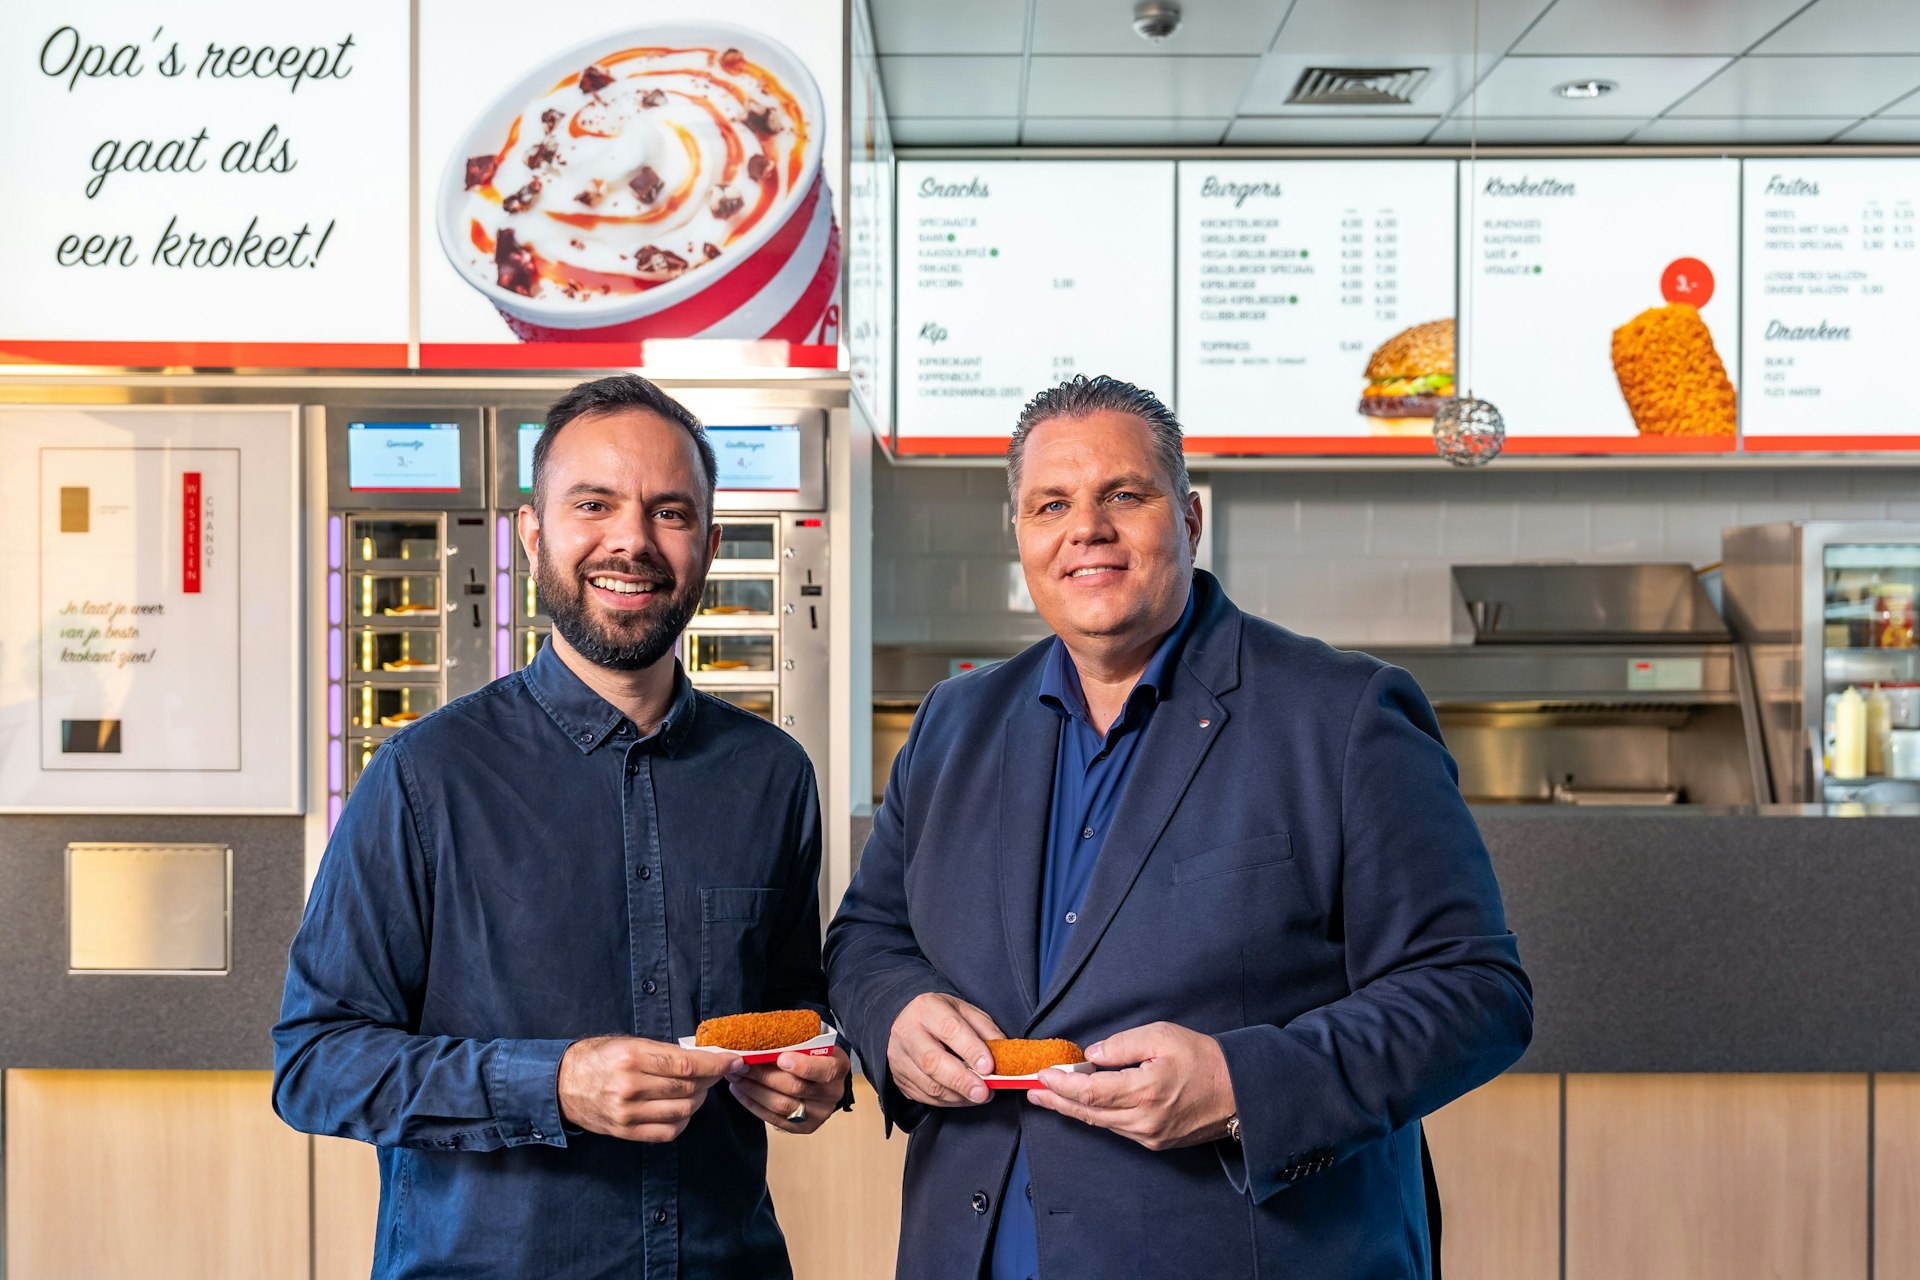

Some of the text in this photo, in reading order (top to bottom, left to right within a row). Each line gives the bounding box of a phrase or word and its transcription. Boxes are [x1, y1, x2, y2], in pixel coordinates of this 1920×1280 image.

[39, 24, 356, 94] Opa's recept
[84, 123, 298, 200] gaat als
[918, 176, 990, 199] Snacks
[1200, 175, 1282, 208] Burgers
[1482, 175, 1576, 197] Kroketten
[1764, 174, 1820, 197] Frites
[55, 215, 336, 270] een kroket!
[919, 321, 948, 345] Kip
[1764, 318, 1851, 341] Dranken
[186, 483, 198, 581] WISSELEN
[204, 495, 216, 569] CHANGE
[59, 600, 165, 625] Je laat je weer
[59, 623, 140, 647] van je beste
[59, 648, 156, 670] krokant zien!
